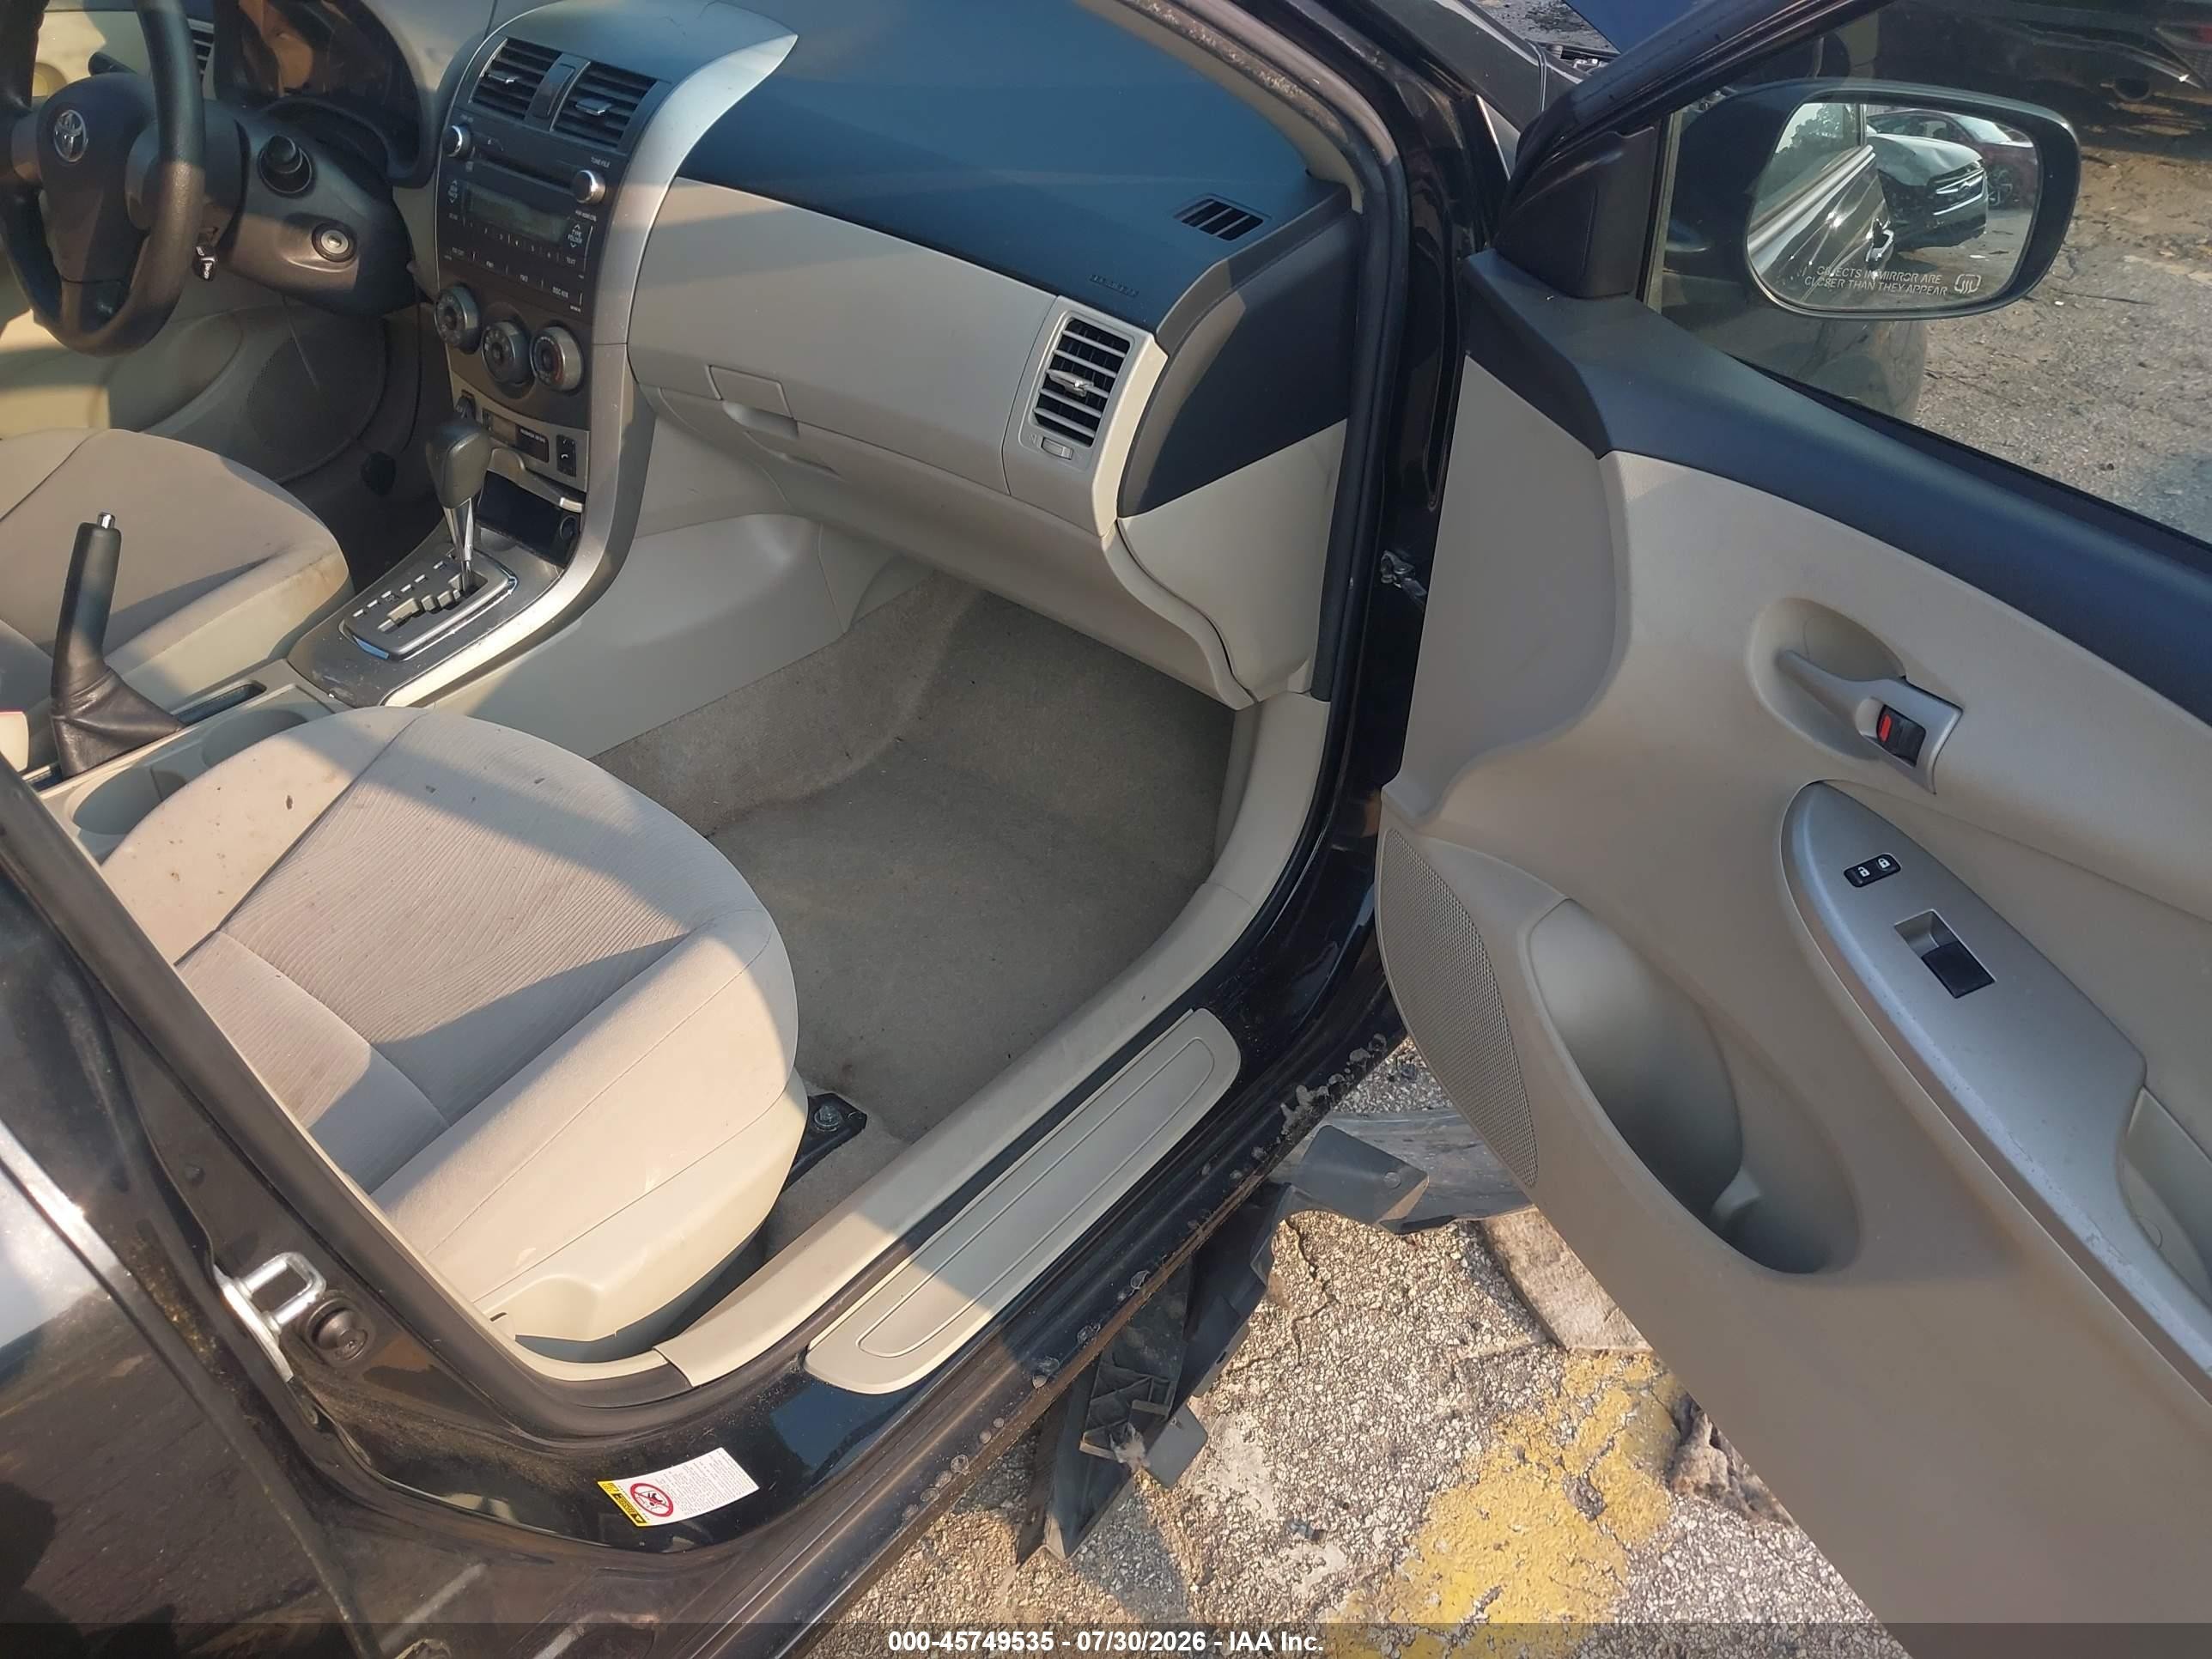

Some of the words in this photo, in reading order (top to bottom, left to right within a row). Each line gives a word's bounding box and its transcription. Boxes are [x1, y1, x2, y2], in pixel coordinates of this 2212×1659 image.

[1816, 265, 1862, 278] OBECTS
[1877, 270, 1918, 283] MIRROR
[1920, 274, 1943, 284] ARE
[1848, 279, 1875, 290] THAN
[1879, 282, 1905, 293] THEY
[1905, 285, 1948, 296] APPEAR
